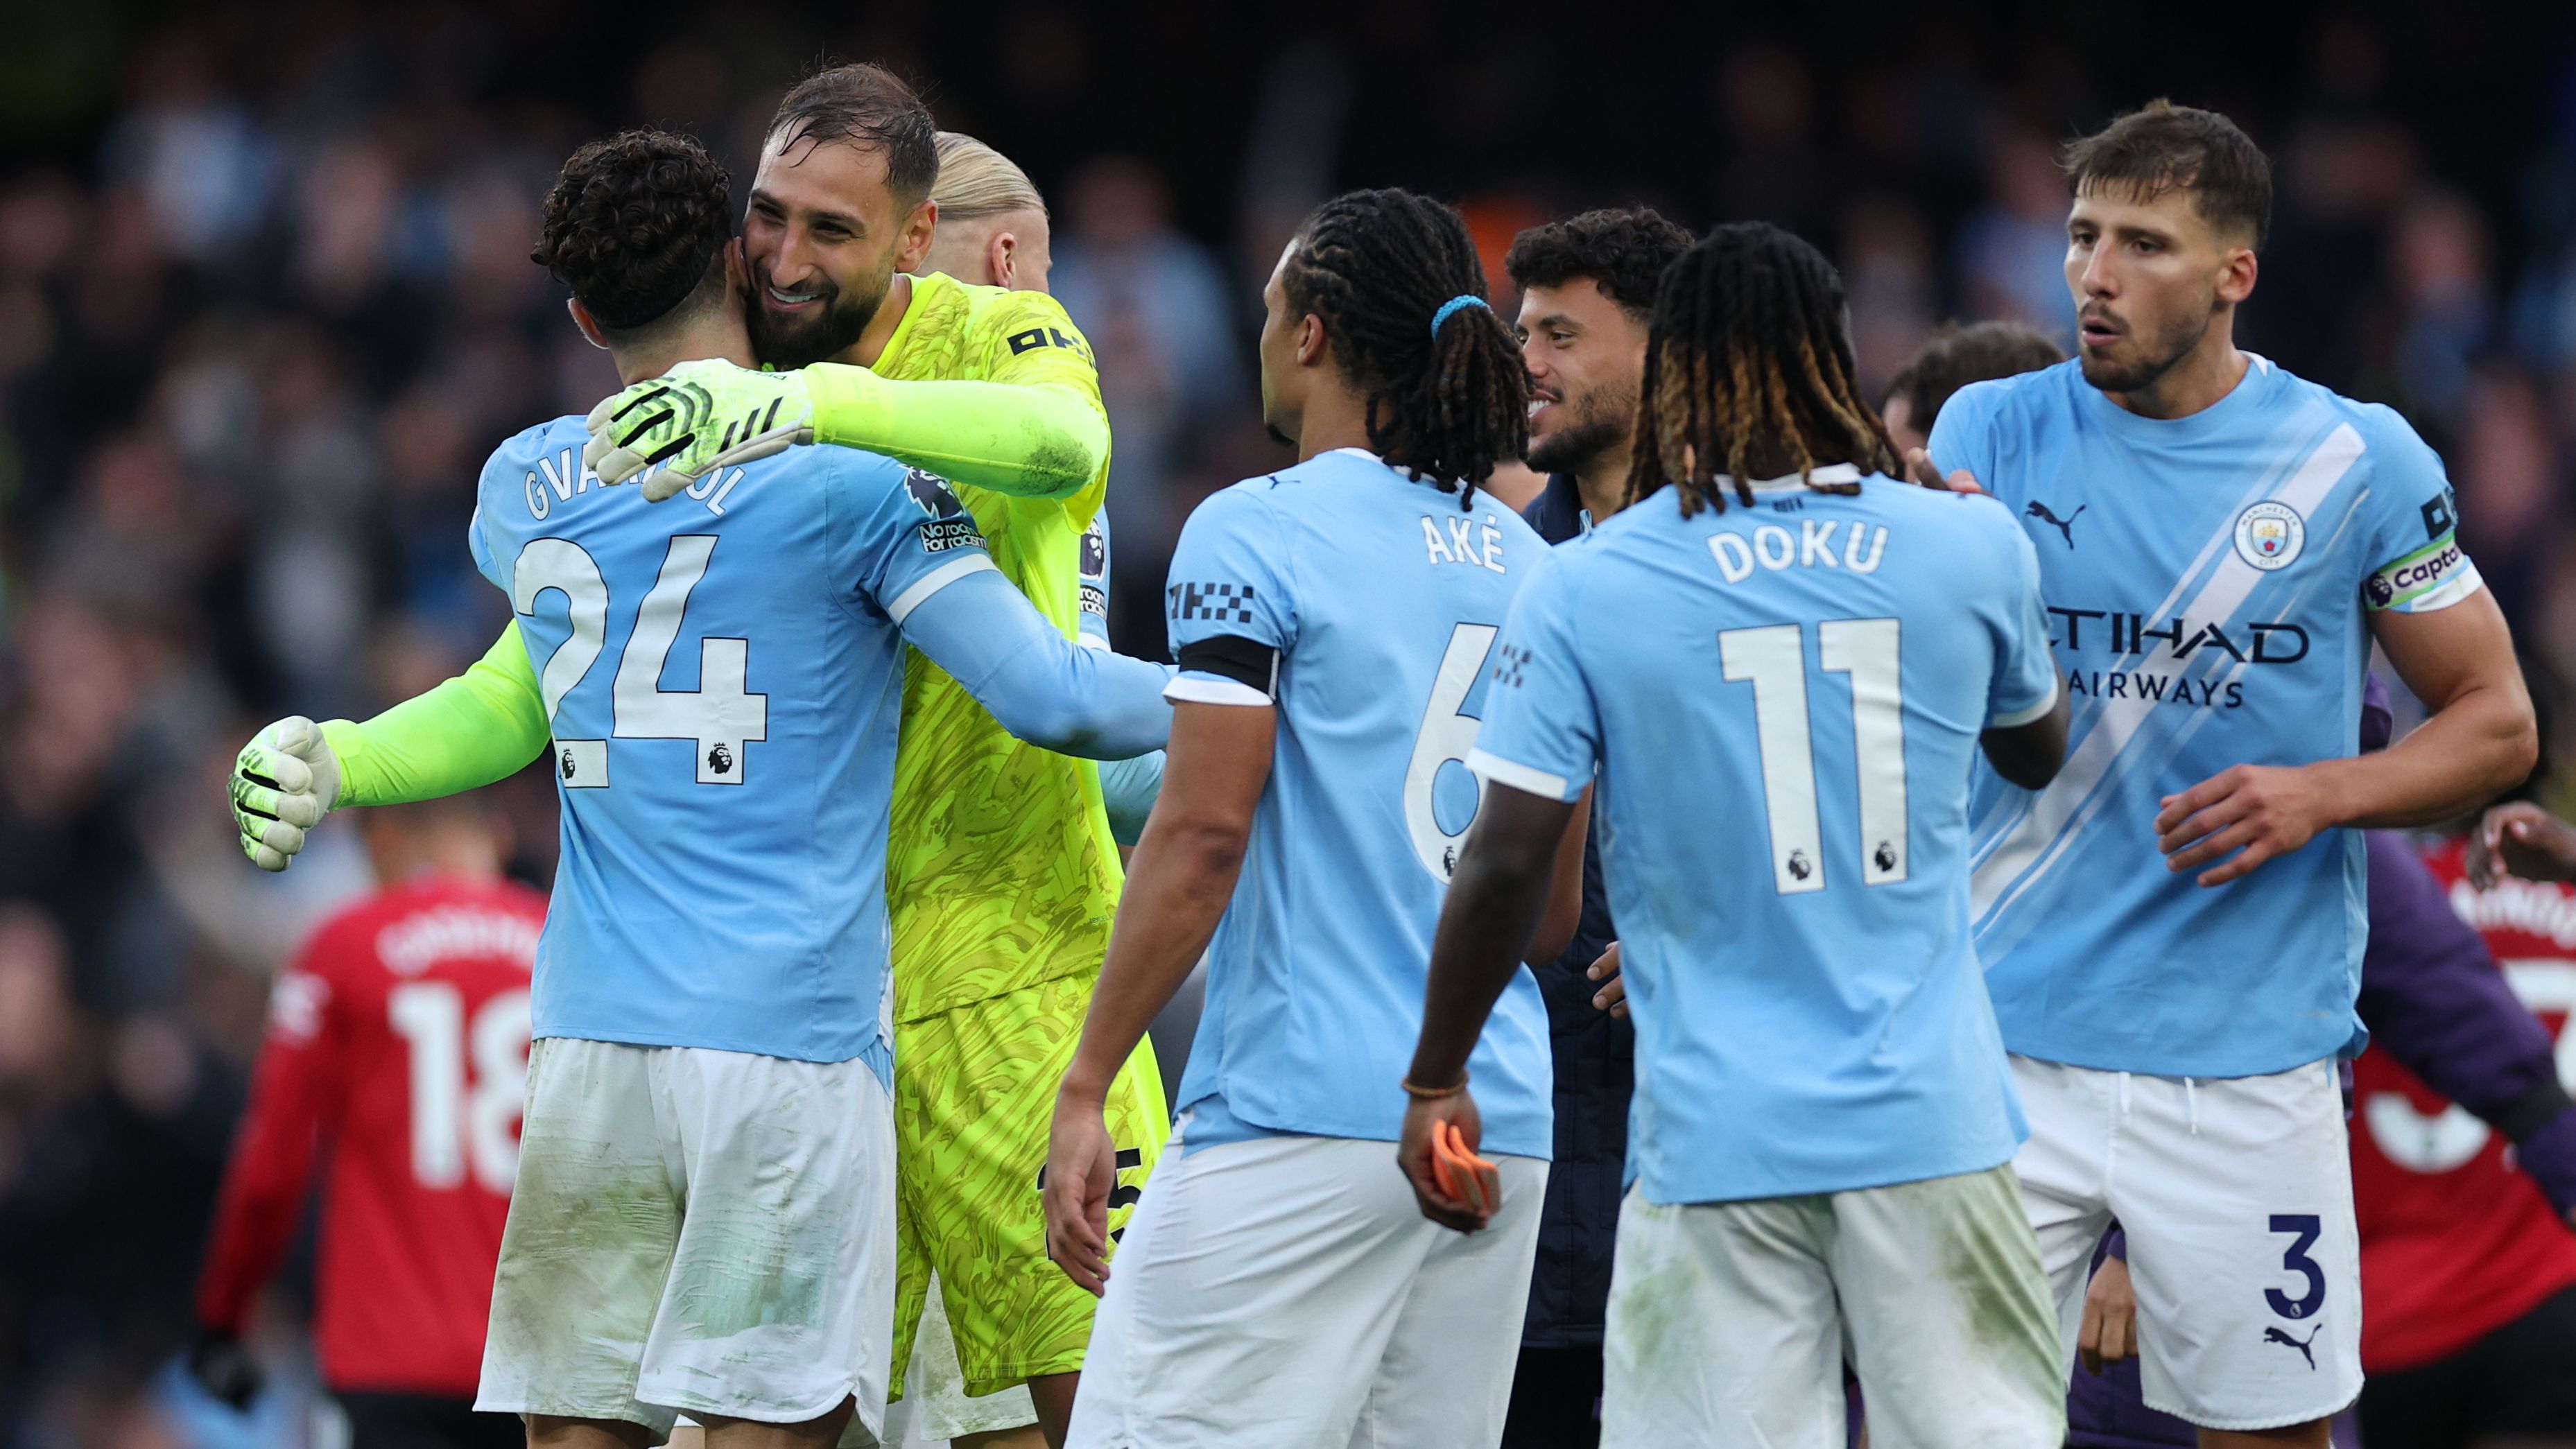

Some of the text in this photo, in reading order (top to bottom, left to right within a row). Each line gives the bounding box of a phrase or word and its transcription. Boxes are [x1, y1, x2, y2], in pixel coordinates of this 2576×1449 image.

[525, 442, 746, 521] GVAOL
[919, 523, 978, 540] No room
[922, 535, 987, 552] for racism
[1420, 514, 1507, 575] AKÉ
[1706, 518, 1890, 584] DOKU
[514, 535, 768, 788] 24
[2047, 606, 2309, 663] TIHAD
[2068, 668, 2244, 708] AIRWAYS
[1403, 622, 1499, 886] 6
[1718, 617, 1908, 895] 11
[2264, 1215, 2326, 1319] 3
